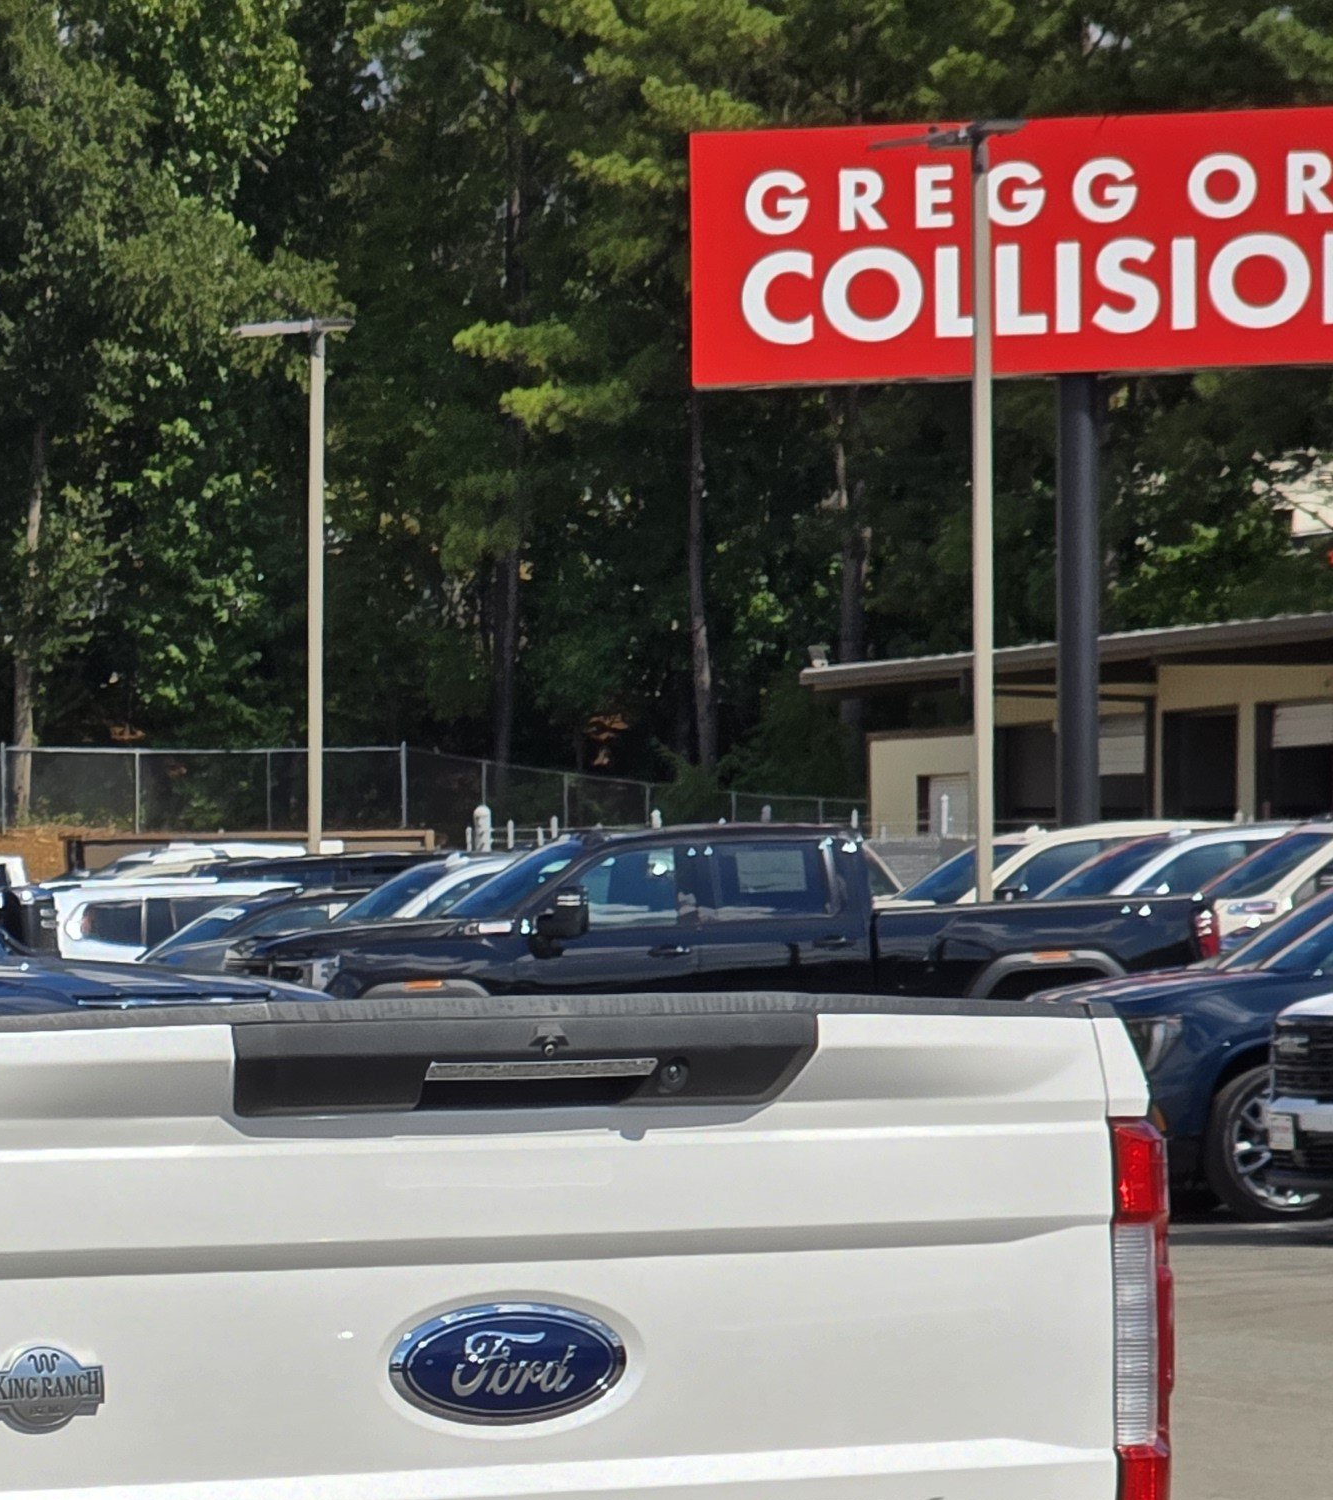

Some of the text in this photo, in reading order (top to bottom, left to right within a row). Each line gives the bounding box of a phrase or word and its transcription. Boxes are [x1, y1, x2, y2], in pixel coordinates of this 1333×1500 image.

[745, 156, 1138, 236] GREGG
[741, 231, 1333, 346] COLLISIO
[41, 1370, 100, 1398] RANCH
[451, 1330, 578, 1397] Ford
